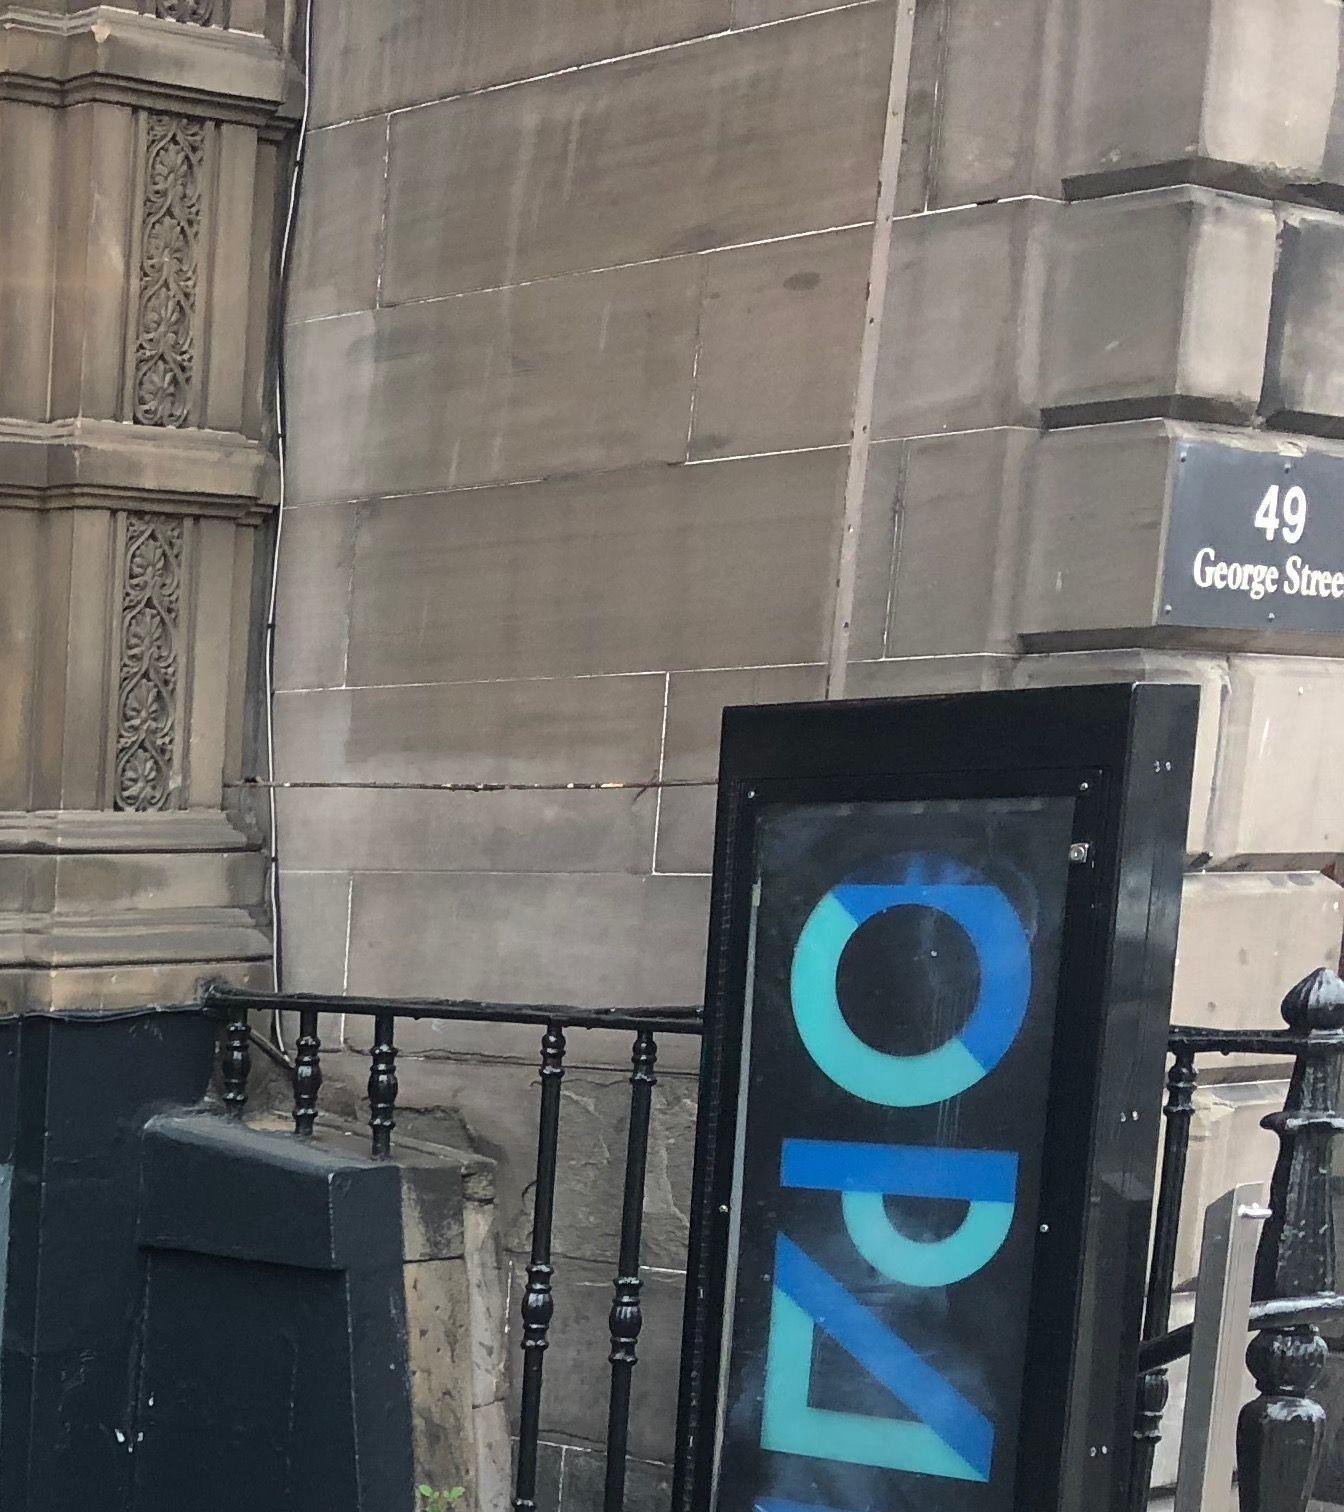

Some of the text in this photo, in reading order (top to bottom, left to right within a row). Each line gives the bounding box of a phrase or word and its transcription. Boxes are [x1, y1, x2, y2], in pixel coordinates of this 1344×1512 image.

[1254, 484, 1307, 544] 49
[1193, 547, 1344, 600] George Stree
